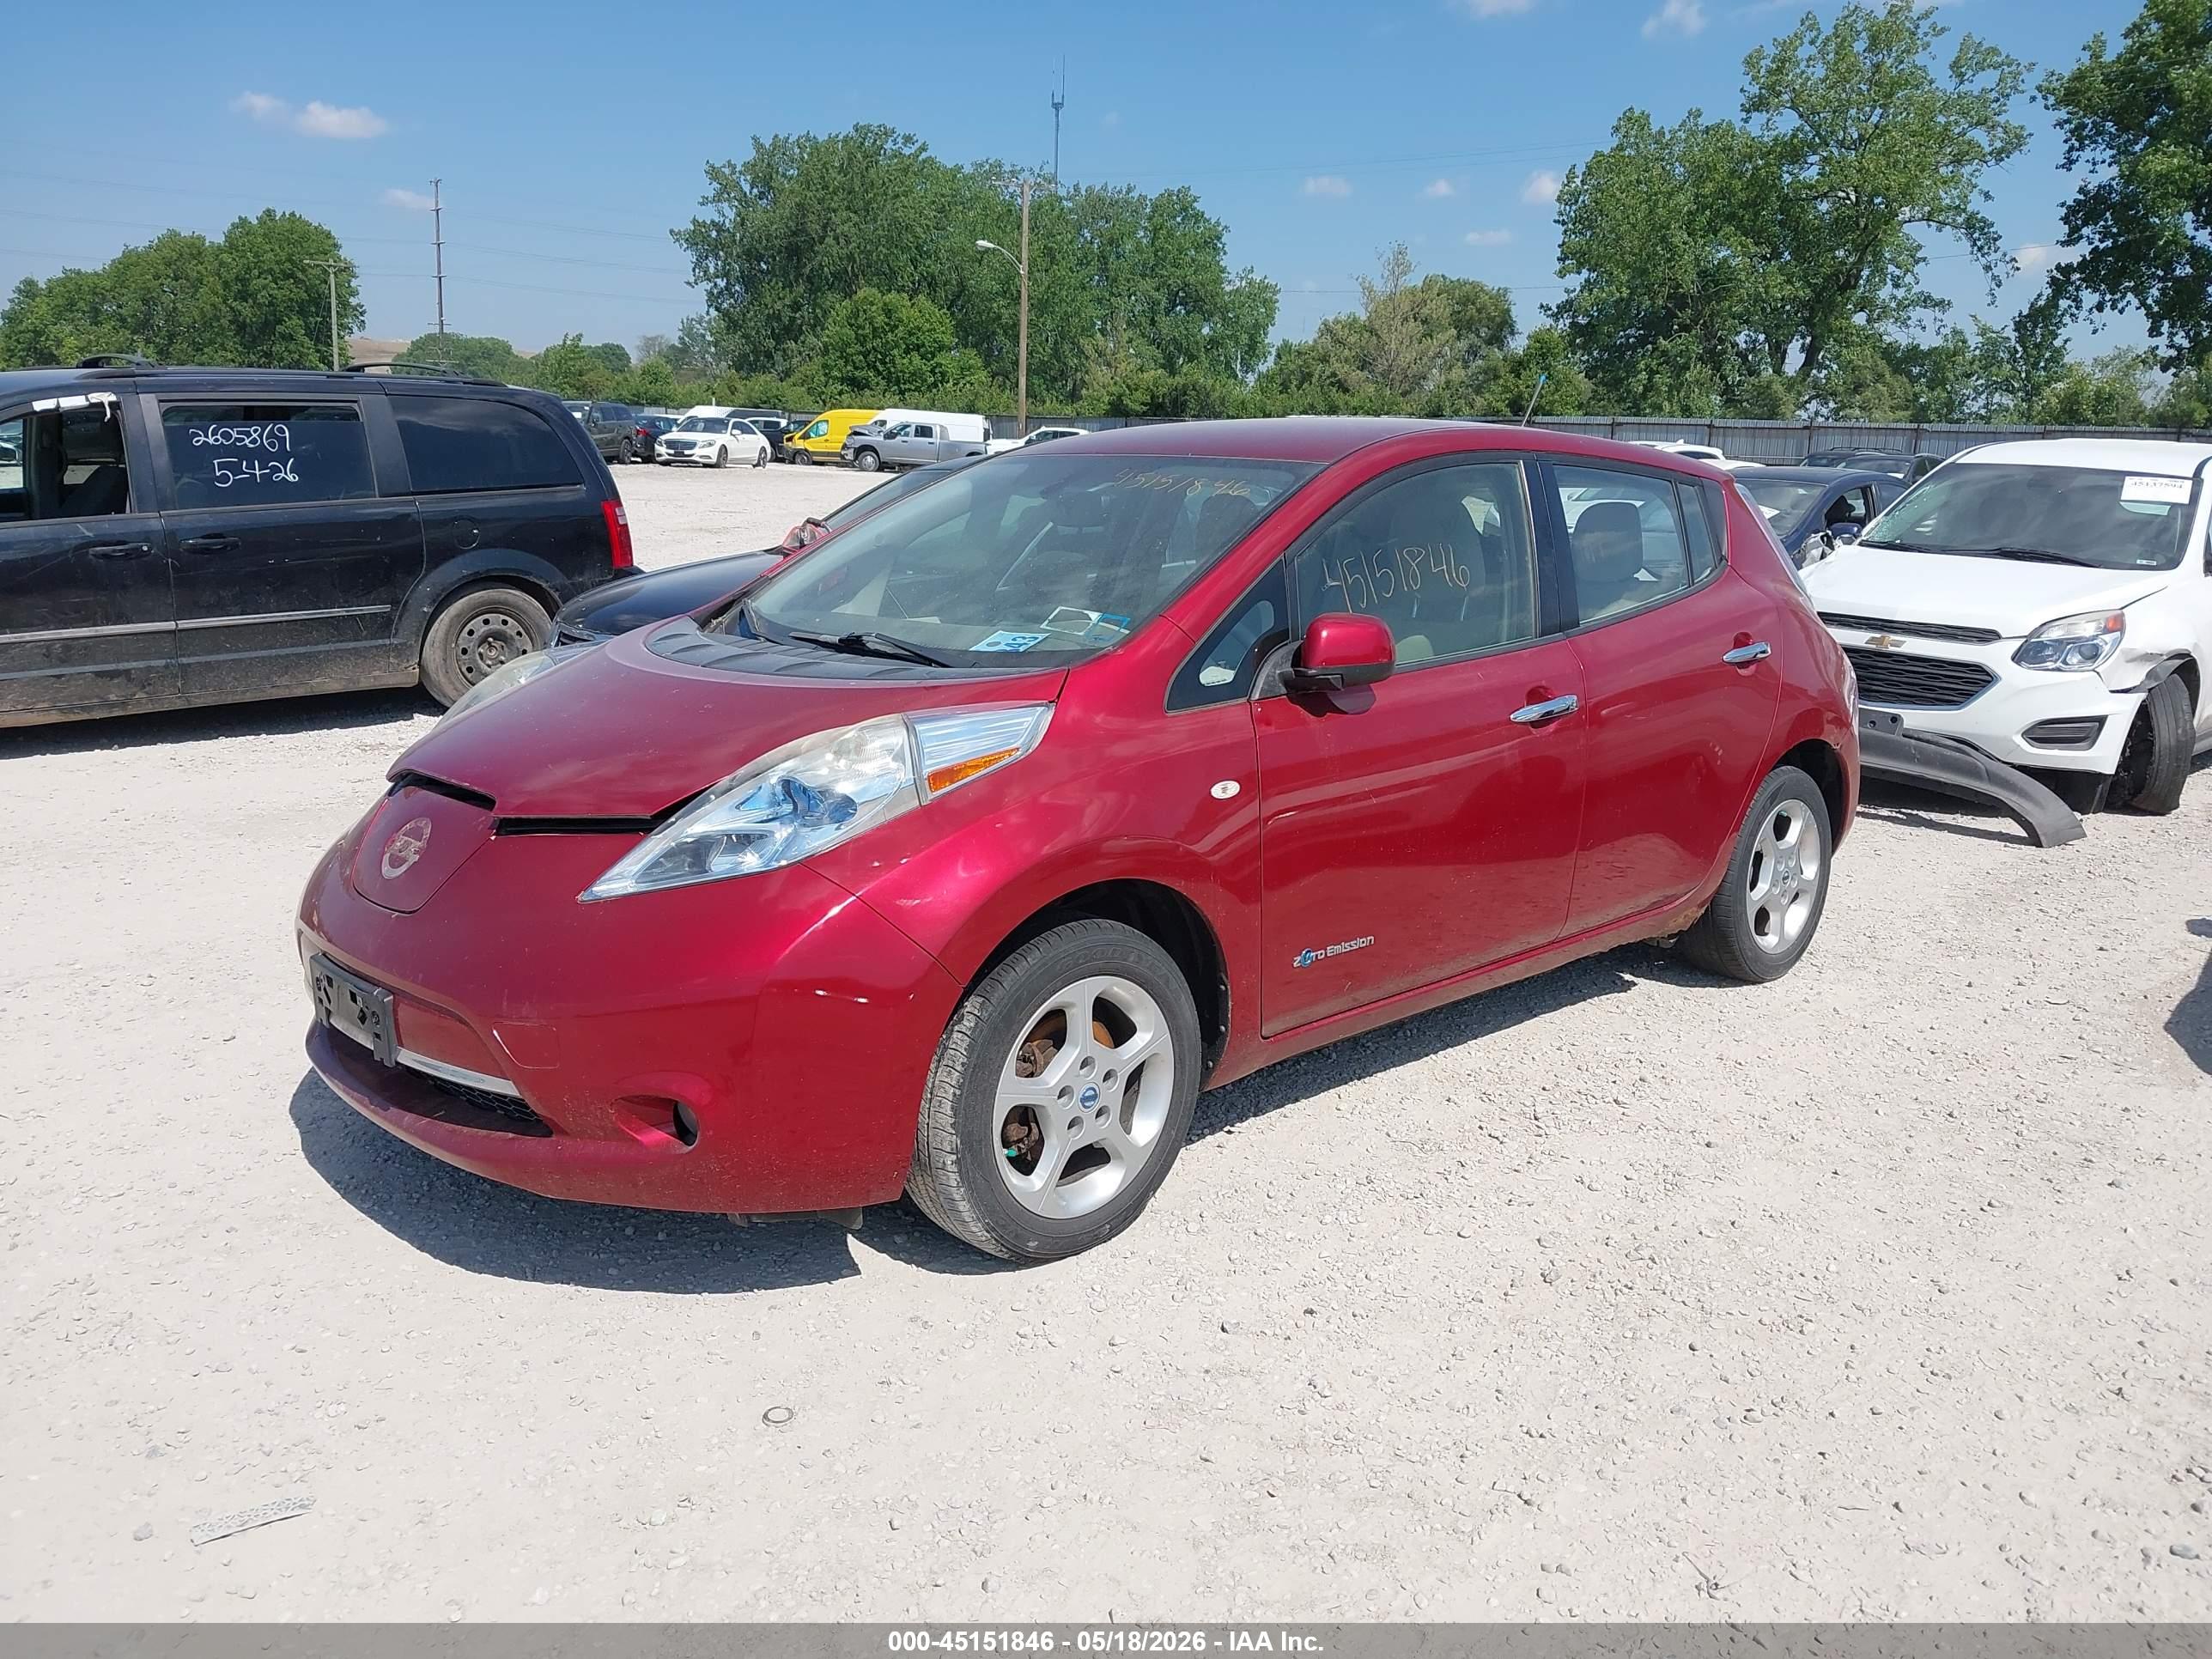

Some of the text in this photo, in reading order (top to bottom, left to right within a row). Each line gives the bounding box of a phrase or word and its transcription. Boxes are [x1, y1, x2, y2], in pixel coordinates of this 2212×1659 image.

[189, 423, 290, 452] 2605869
[213, 458, 299, 487] 5-4-26
[1115, 468, 1251, 496] 45151846
[1321, 543, 1470, 614] 45151846
[1326, 935, 1375, 957] Emission
